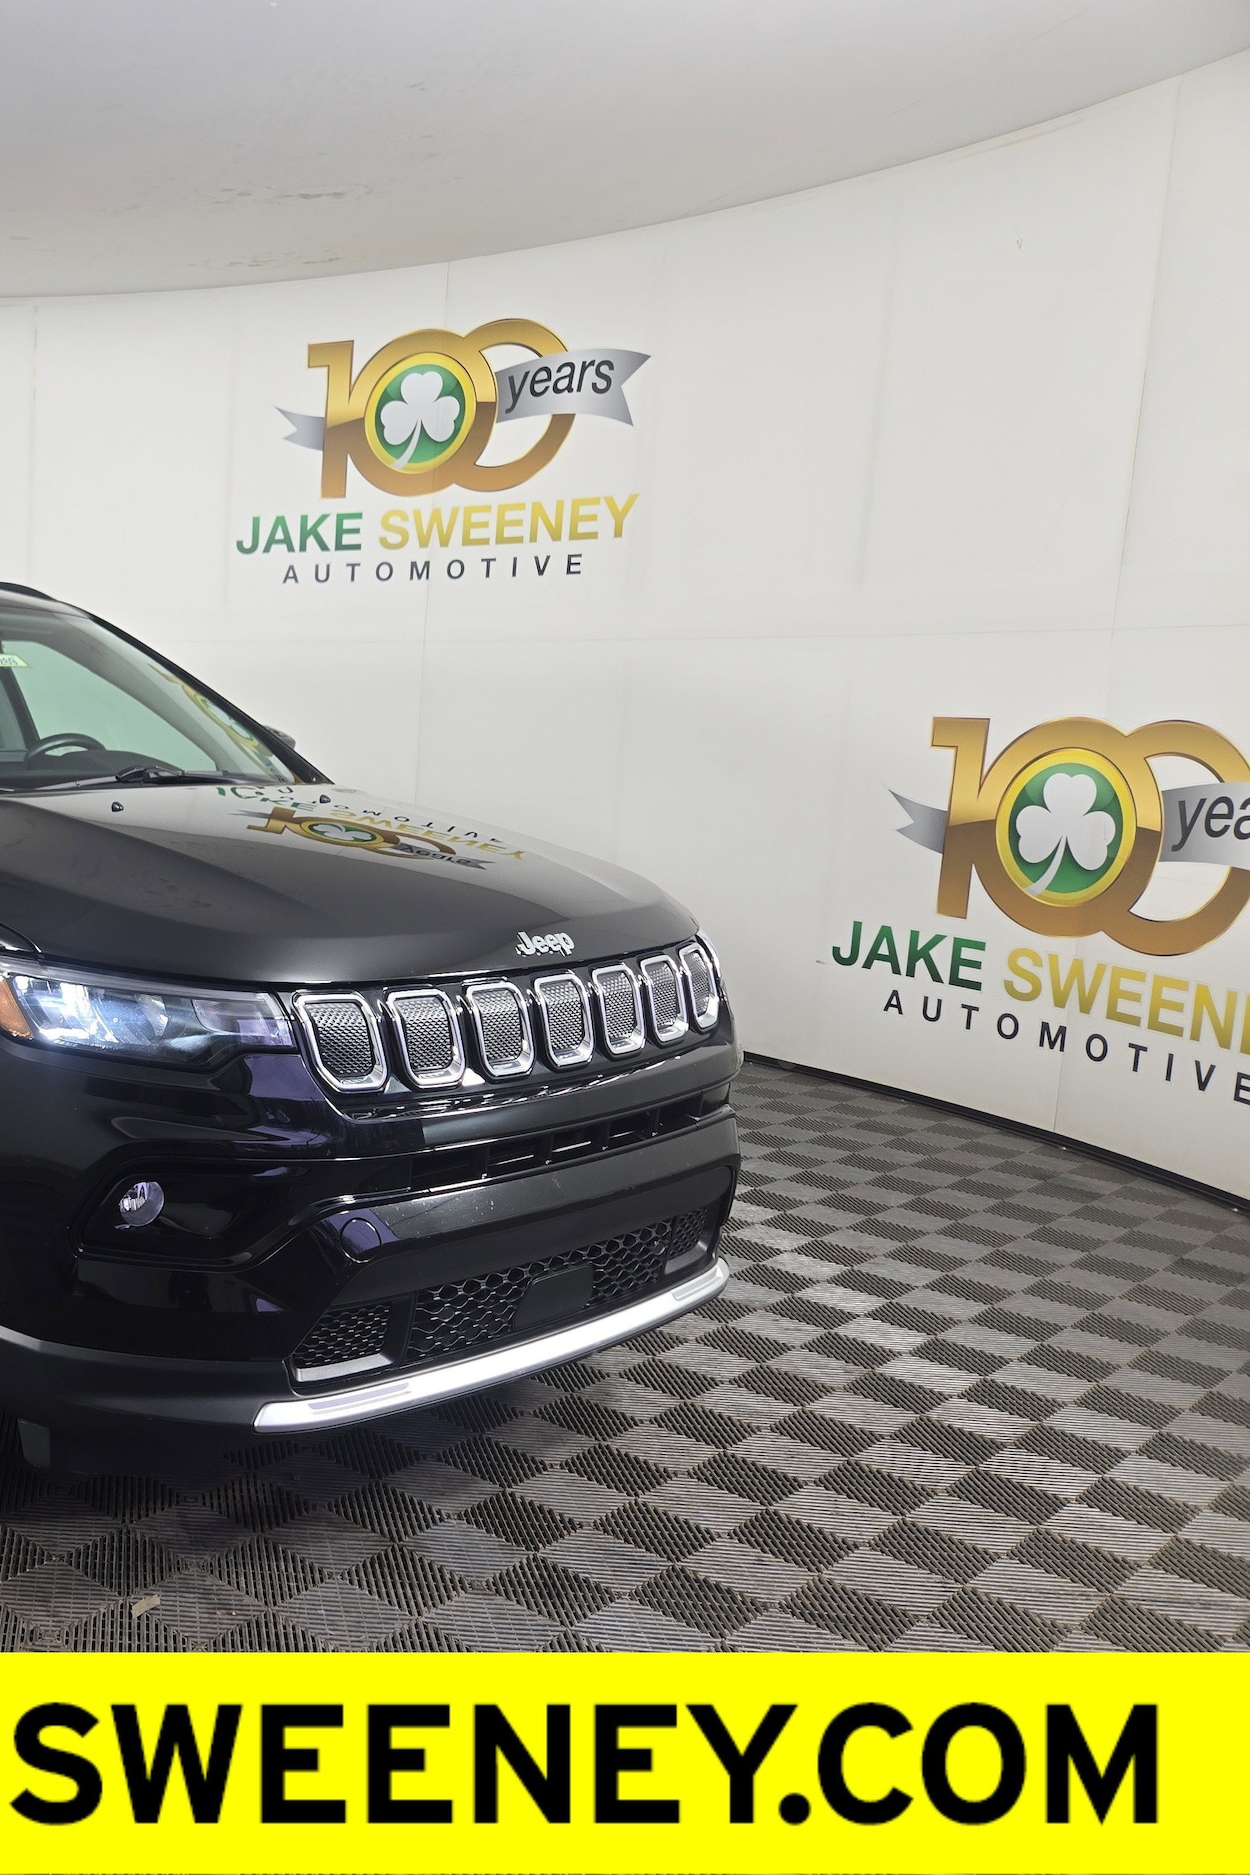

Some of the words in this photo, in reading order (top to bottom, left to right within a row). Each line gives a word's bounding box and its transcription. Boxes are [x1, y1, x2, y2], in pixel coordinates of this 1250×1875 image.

[504, 357, 616, 415] years
[235, 511, 364, 556] JAKE
[378, 493, 640, 551] SWEENEY
[281, 553, 584, 585] AUTOMOTIVE
[514, 931, 575, 957] Jeep
[831, 920, 987, 993] JAKE
[1003, 947, 1250, 1056] SWEEN
[883, 989, 1250, 1106] AUTOMOTIVE
